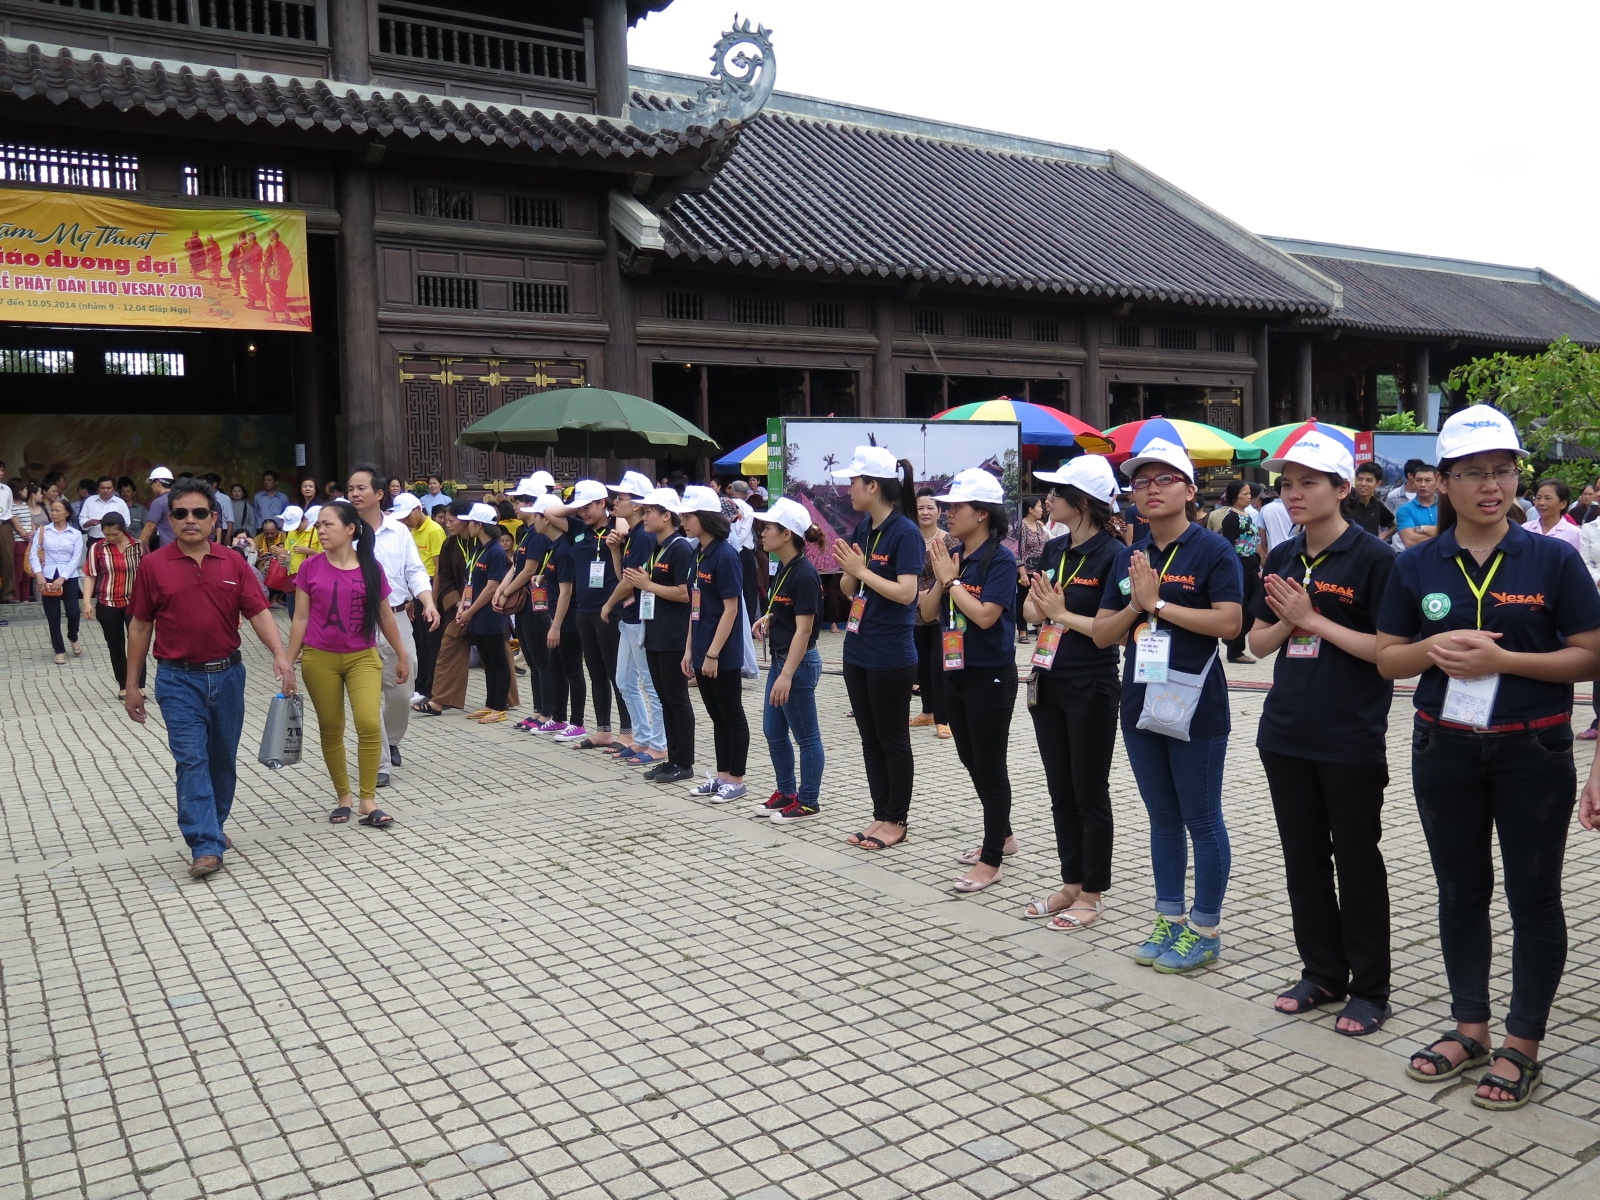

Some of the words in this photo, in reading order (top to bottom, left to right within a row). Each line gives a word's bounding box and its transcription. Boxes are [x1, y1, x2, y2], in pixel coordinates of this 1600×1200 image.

[33, 222, 97, 253] Mỹ
[95, 225, 168, 251] Thuật
[45, 249, 132, 276] đương
[136, 254, 178, 278] đại
[0, 270, 10, 289] Ễ
[14, 275, 53, 293] PHẬT
[91, 280, 118, 296] LHQ
[121, 282, 165, 297] VESAK
[169, 284, 203, 298] 2014
[27, 300, 76, 309] 10.05.2014
[123, 303, 146, 312] 12.04
[767, 460, 782, 470] 2014
[349, 577, 367, 634] PARIS
[1339, 596, 1354, 605] 2014
